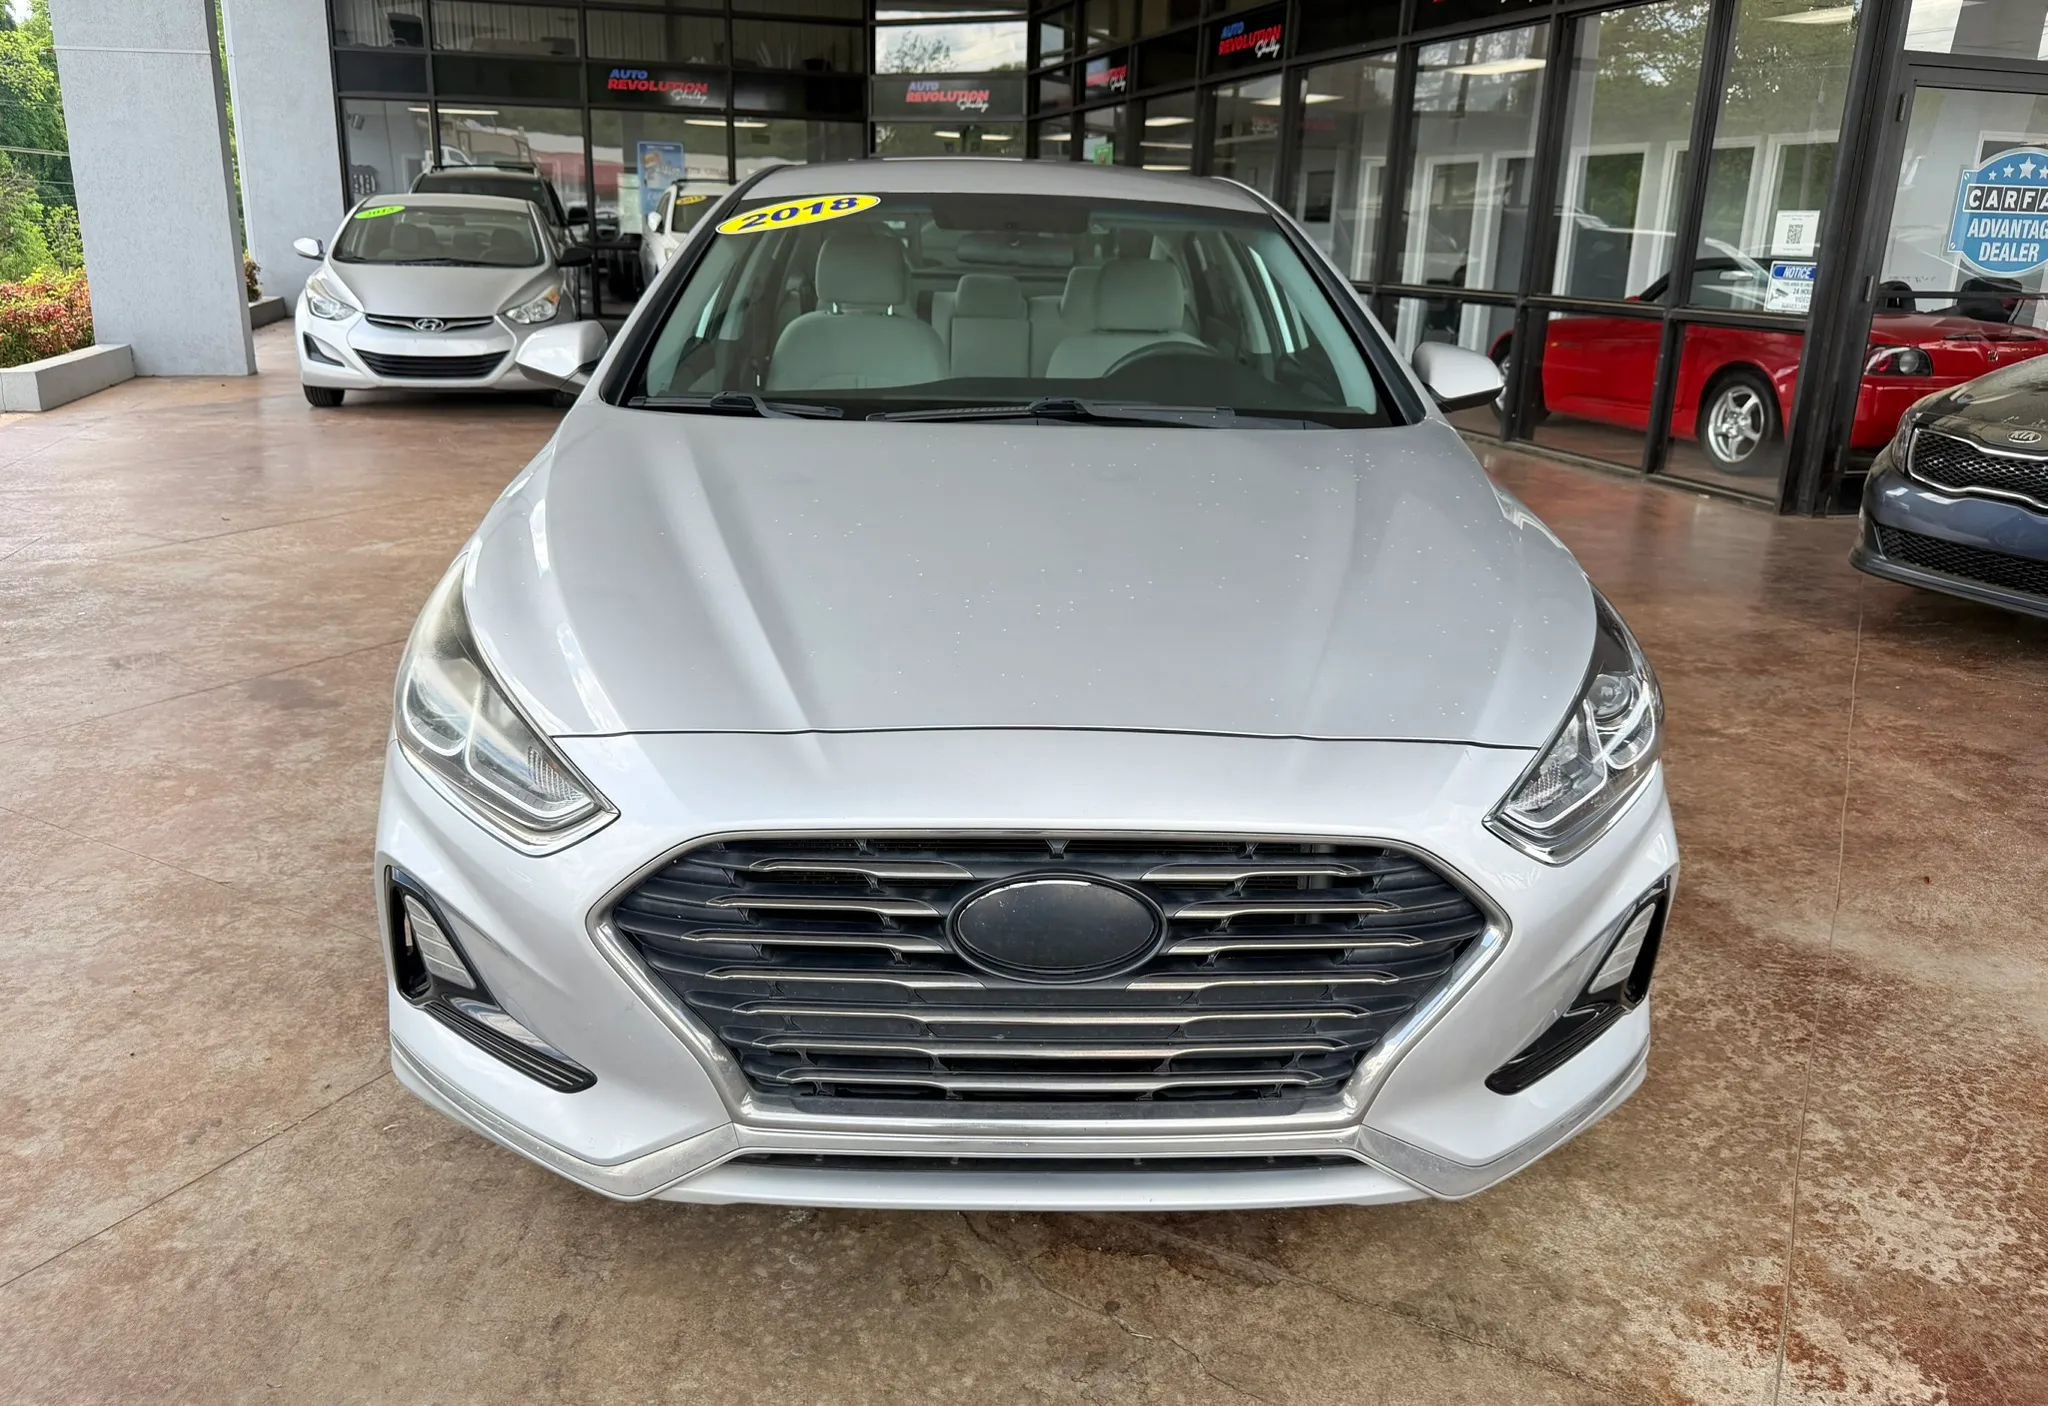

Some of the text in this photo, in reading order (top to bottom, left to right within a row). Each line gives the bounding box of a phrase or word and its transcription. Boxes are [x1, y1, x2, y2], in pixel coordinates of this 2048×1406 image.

[609, 69, 648, 79] AUTO
[607, 79, 709, 93] REVOLUTION
[908, 81, 939, 92] AUTO
[905, 90, 989, 103] REVOLUTION
[738, 197, 858, 231] 2018
[1979, 242, 2040, 262] DEALER
[1782, 266, 1812, 279] NOTICE
[2010, 431, 2035, 441] KIA
